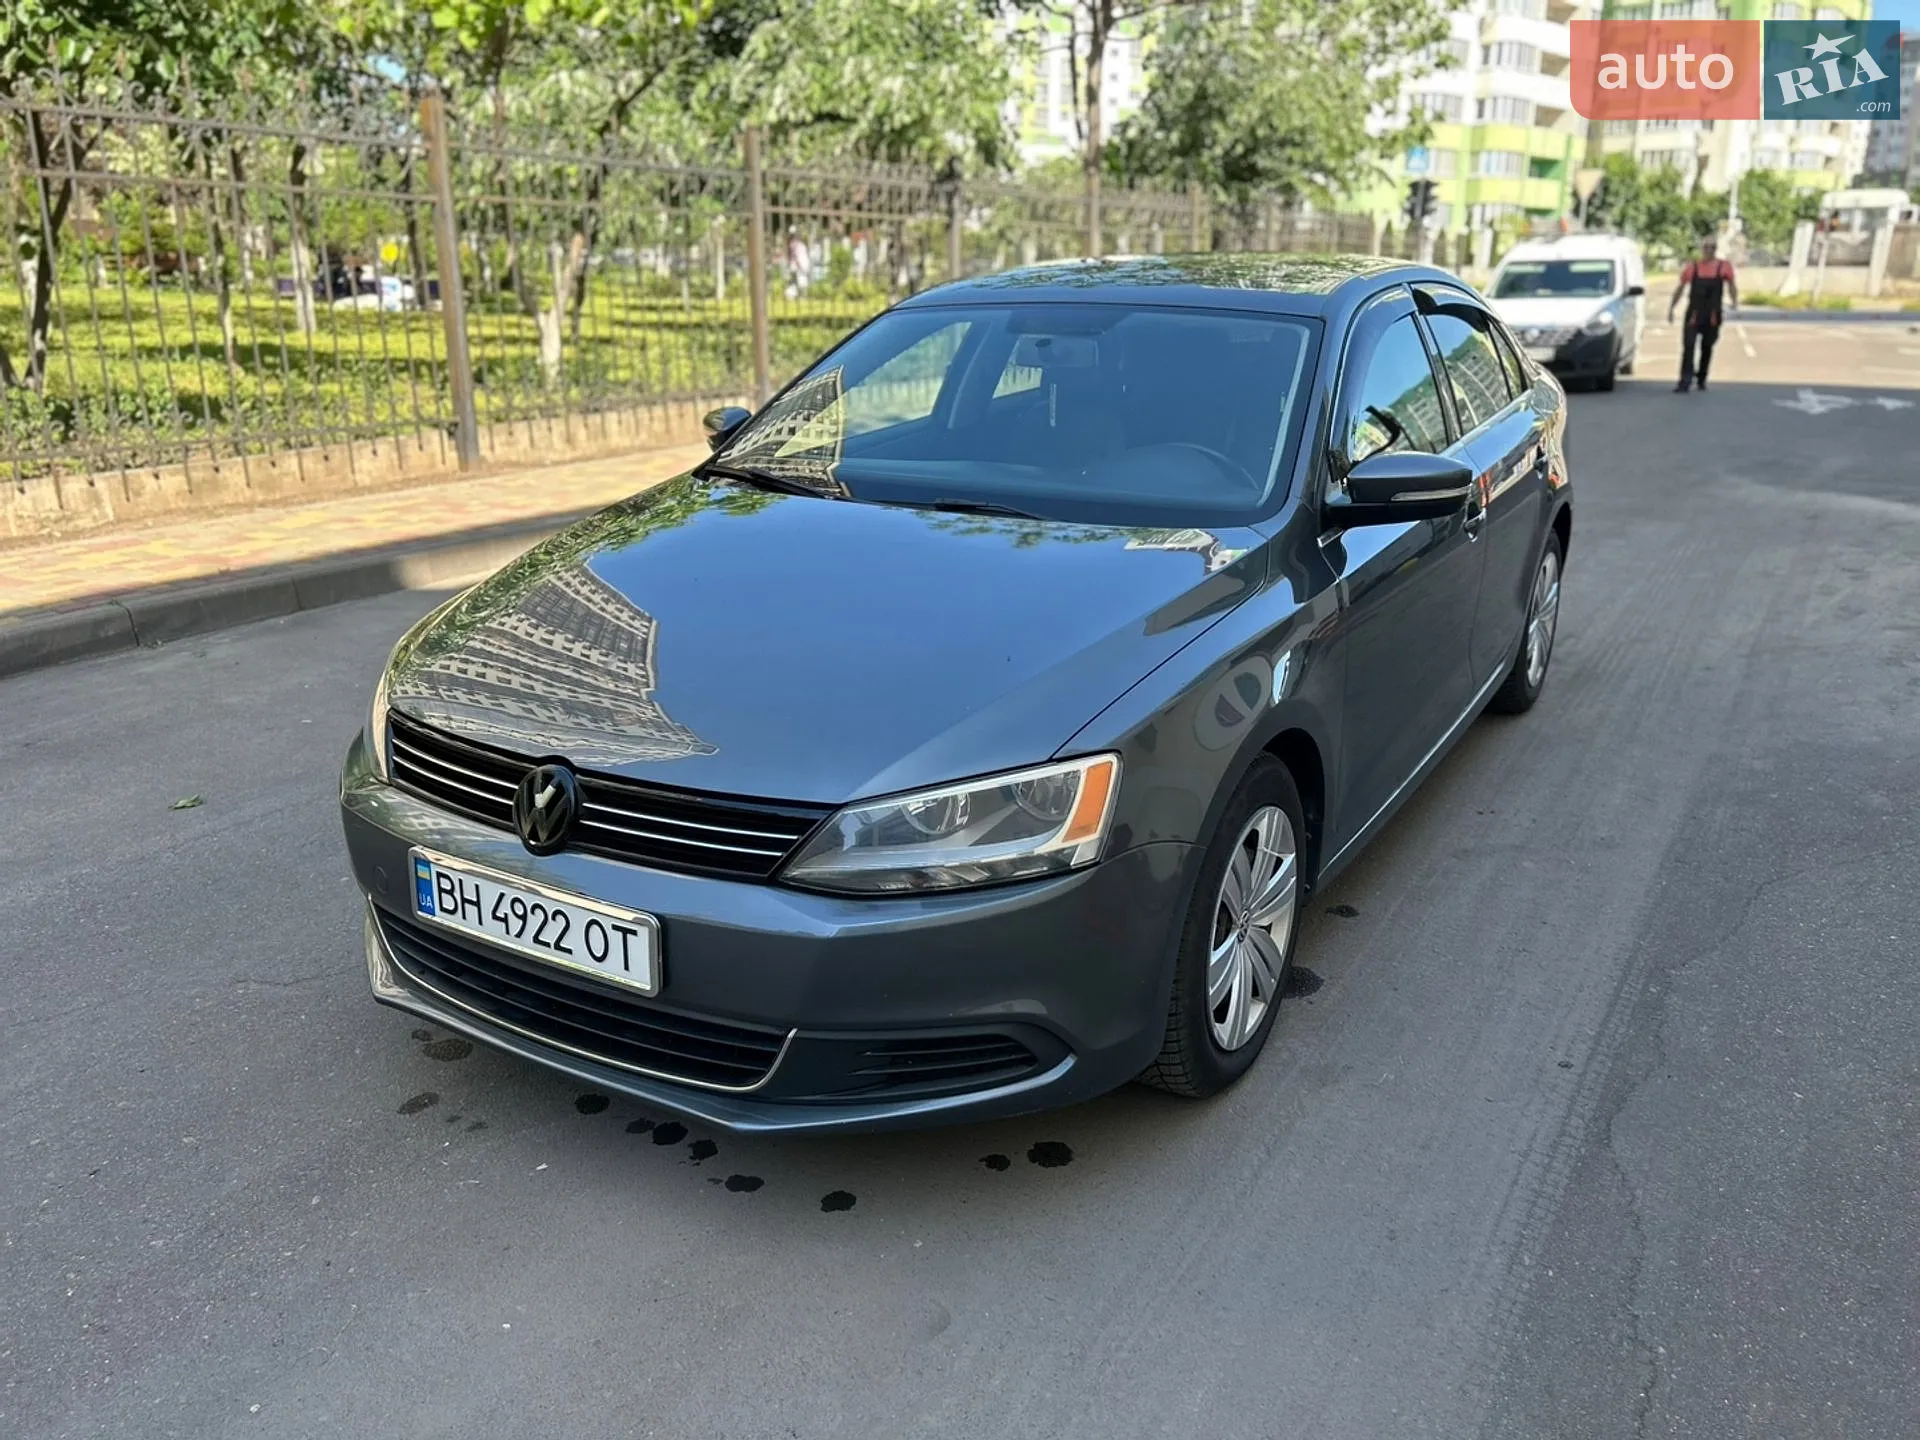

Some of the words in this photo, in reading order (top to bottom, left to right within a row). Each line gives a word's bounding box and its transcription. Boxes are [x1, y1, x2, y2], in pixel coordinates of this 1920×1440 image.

[419, 893, 434, 910] UA
[437, 872, 484, 926] BH
[491, 892, 573, 955] 4922
[584, 918, 638, 971] OT
